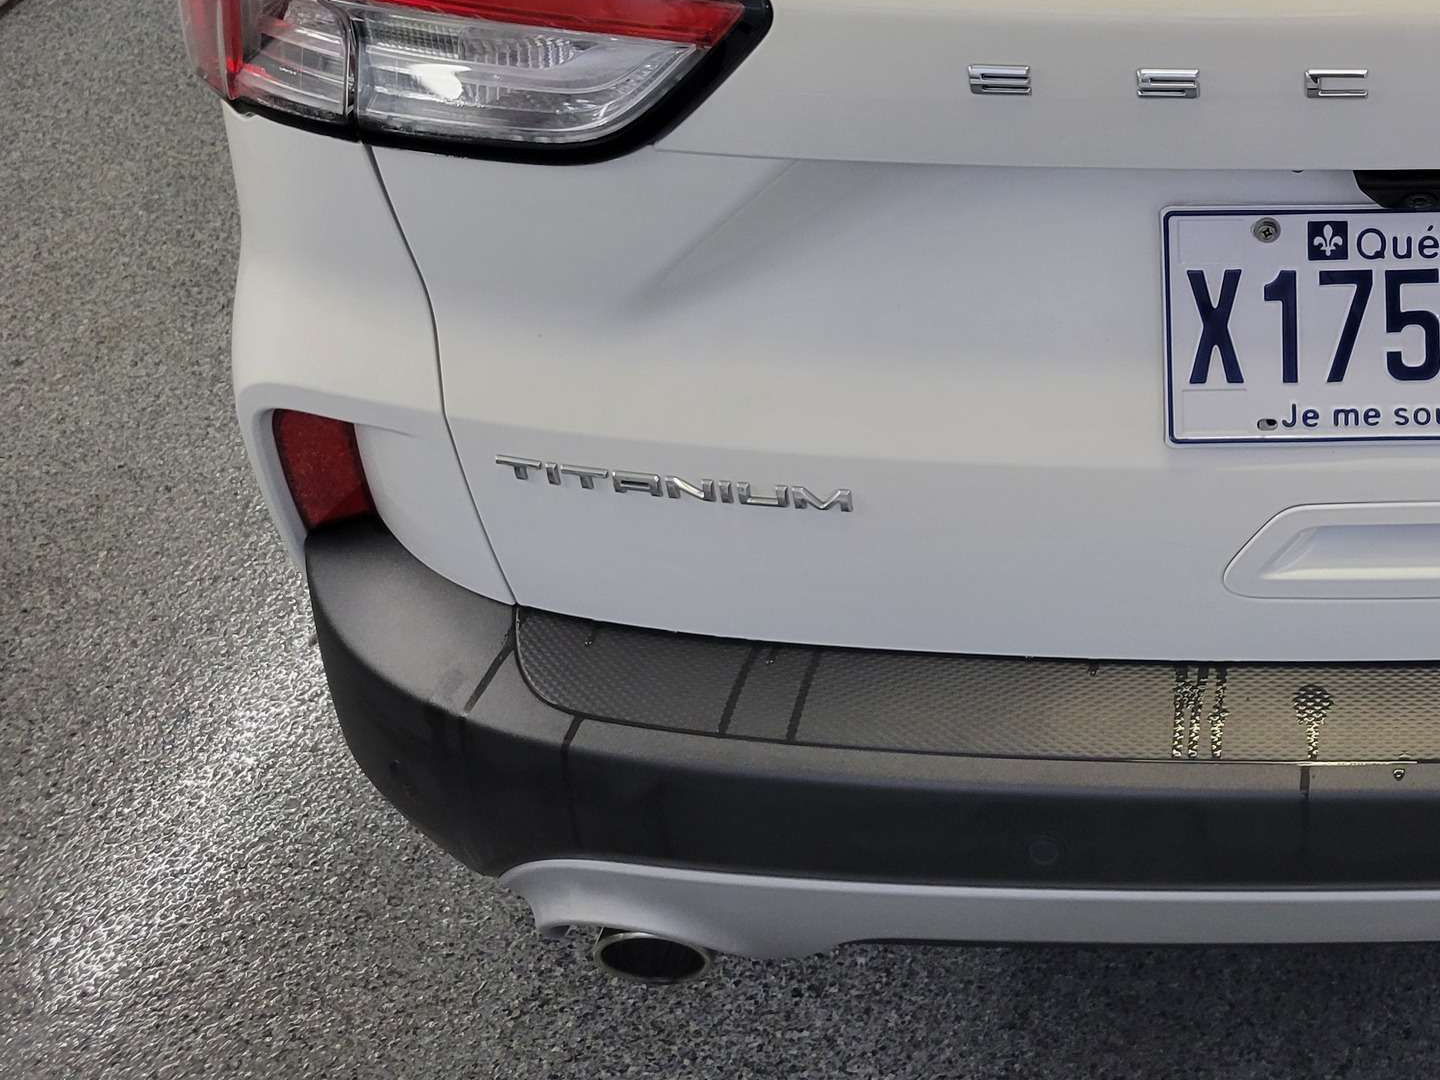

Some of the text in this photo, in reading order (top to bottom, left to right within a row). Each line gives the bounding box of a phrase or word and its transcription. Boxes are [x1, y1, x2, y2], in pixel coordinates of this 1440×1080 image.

[1282, 403, 1319, 428] Je
[1333, 407, 1381, 427] me
[496, 454, 853, 513] TITANIUM
